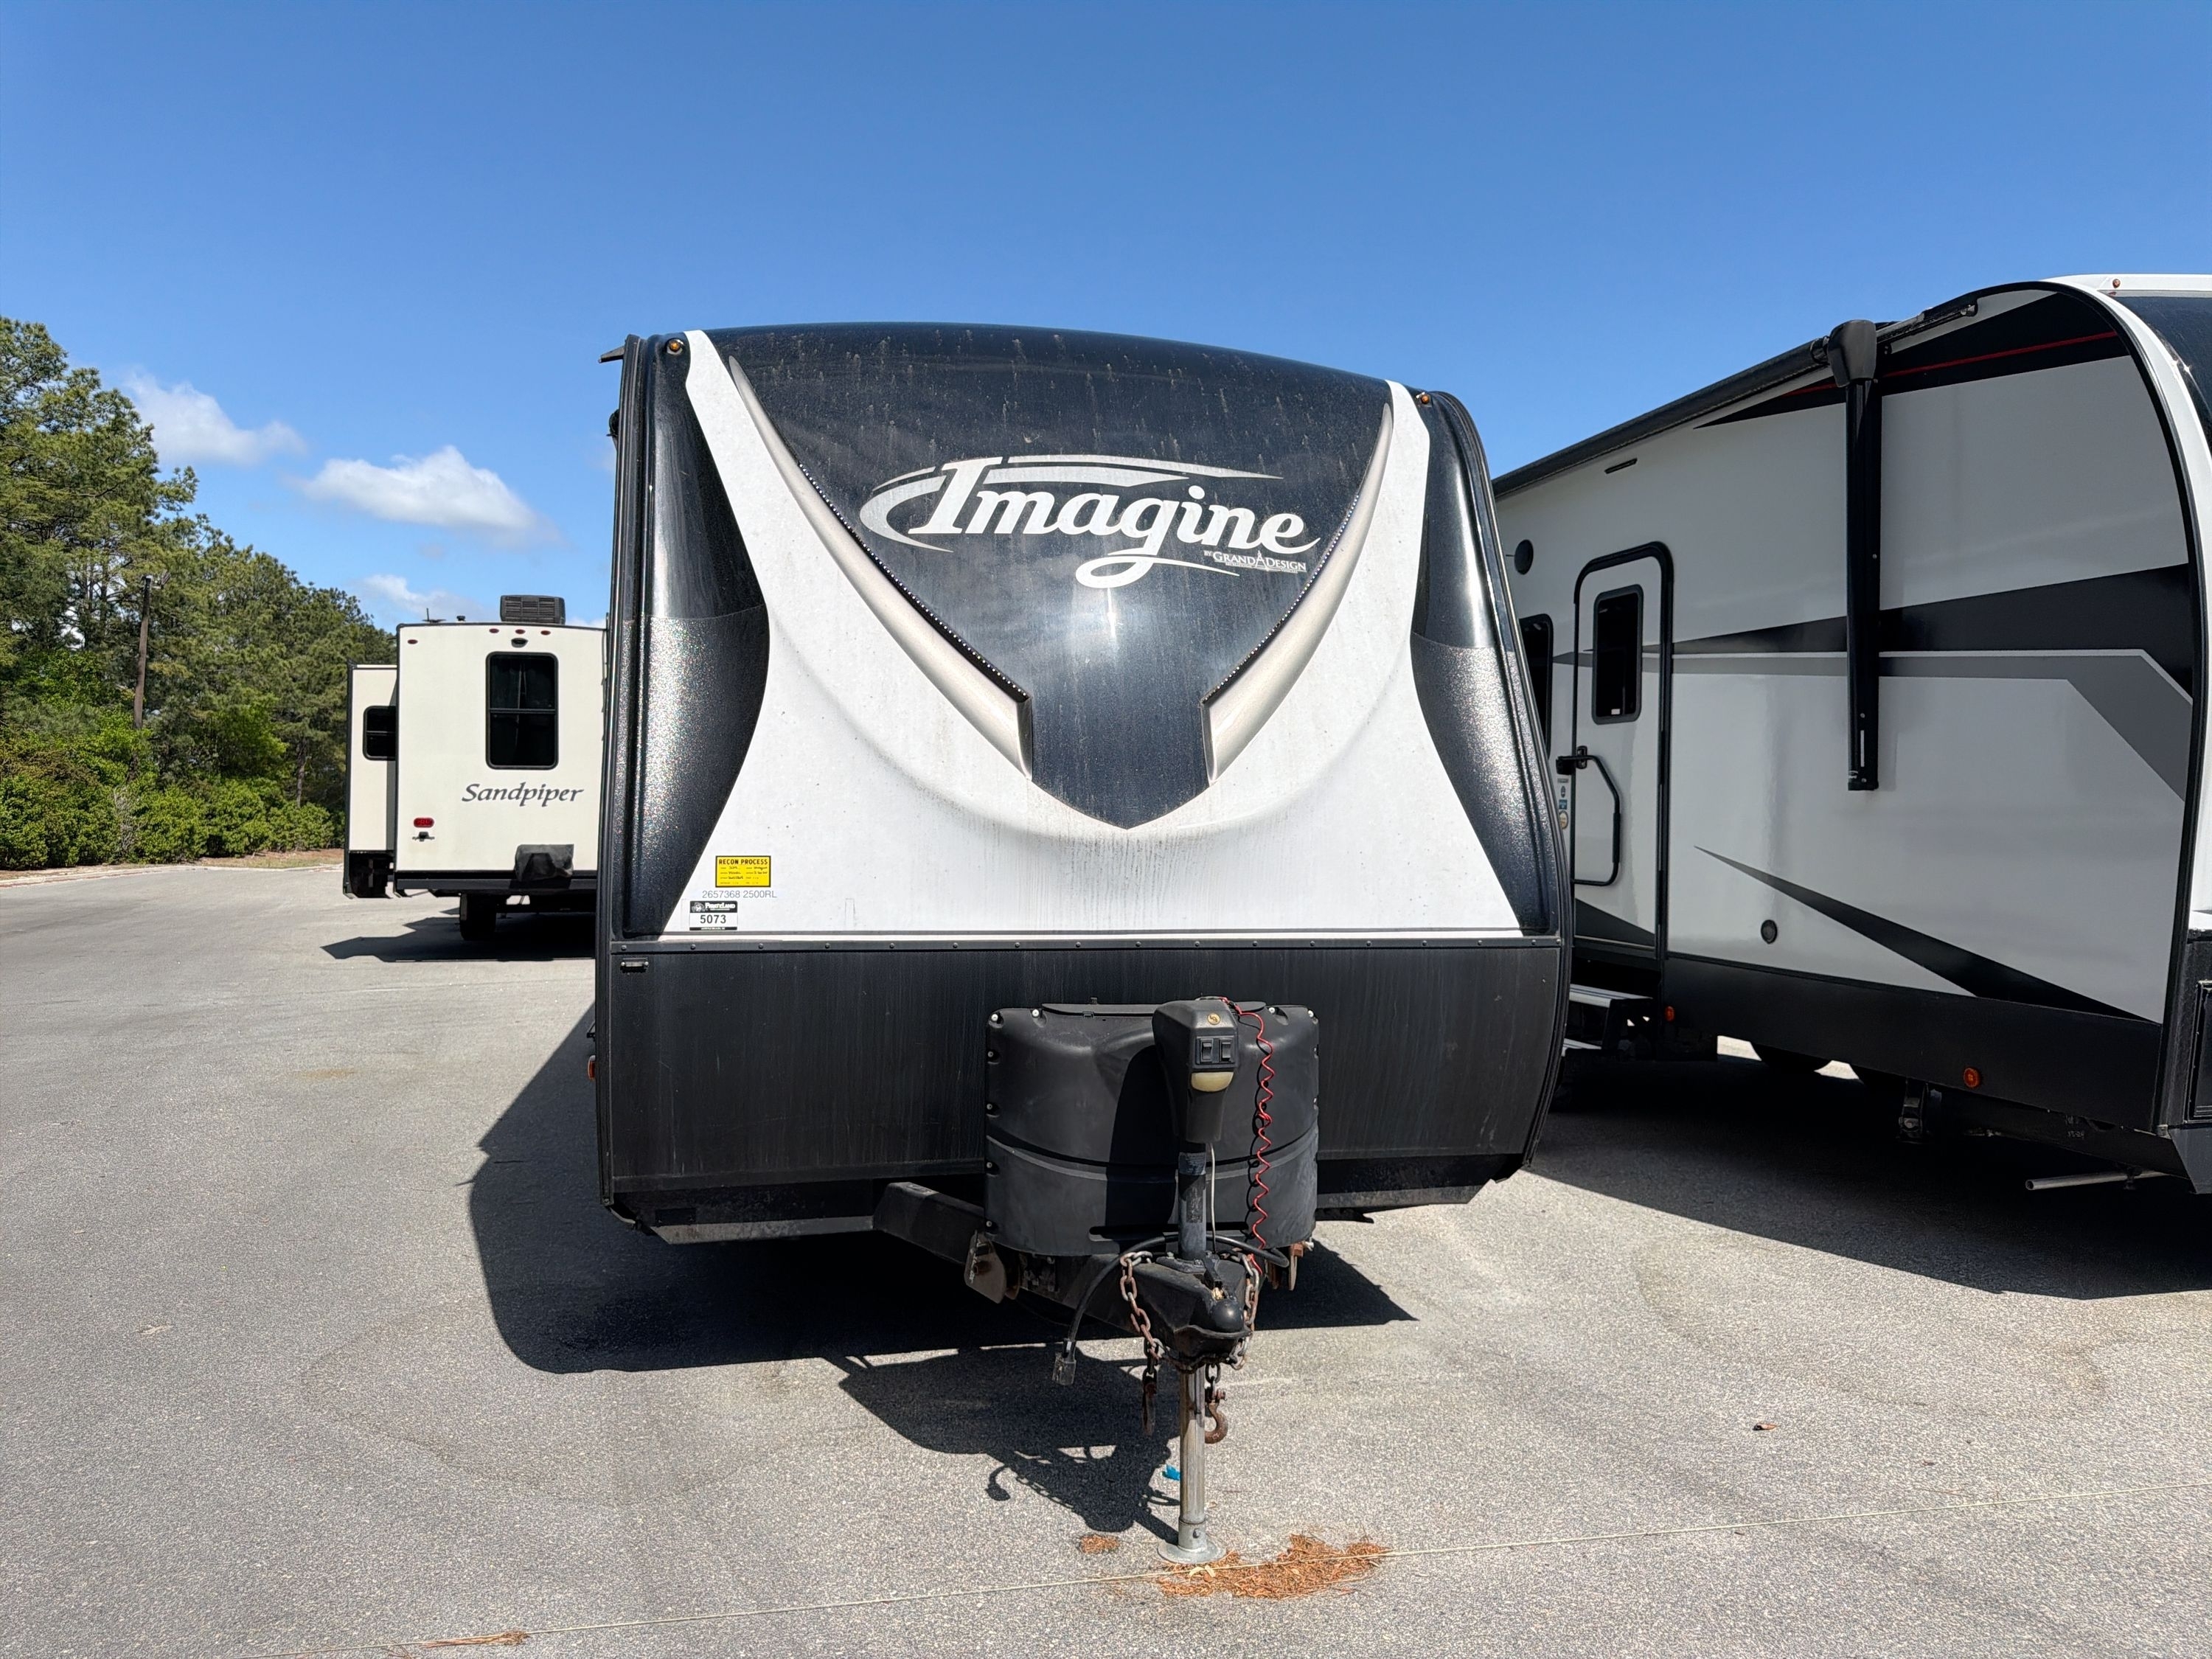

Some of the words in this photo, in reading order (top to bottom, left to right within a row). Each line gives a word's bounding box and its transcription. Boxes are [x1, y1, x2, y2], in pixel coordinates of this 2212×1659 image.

[908, 455, 1321, 589] Imagine
[1212, 552, 1254, 565] GRAND
[1266, 557, 1307, 571] DESIGN
[461, 781, 585, 808] Sandpiper
[701, 890, 741, 899] 2657368
[742, 890, 778, 899] 2500RL
[700, 914, 726, 924] 5073
